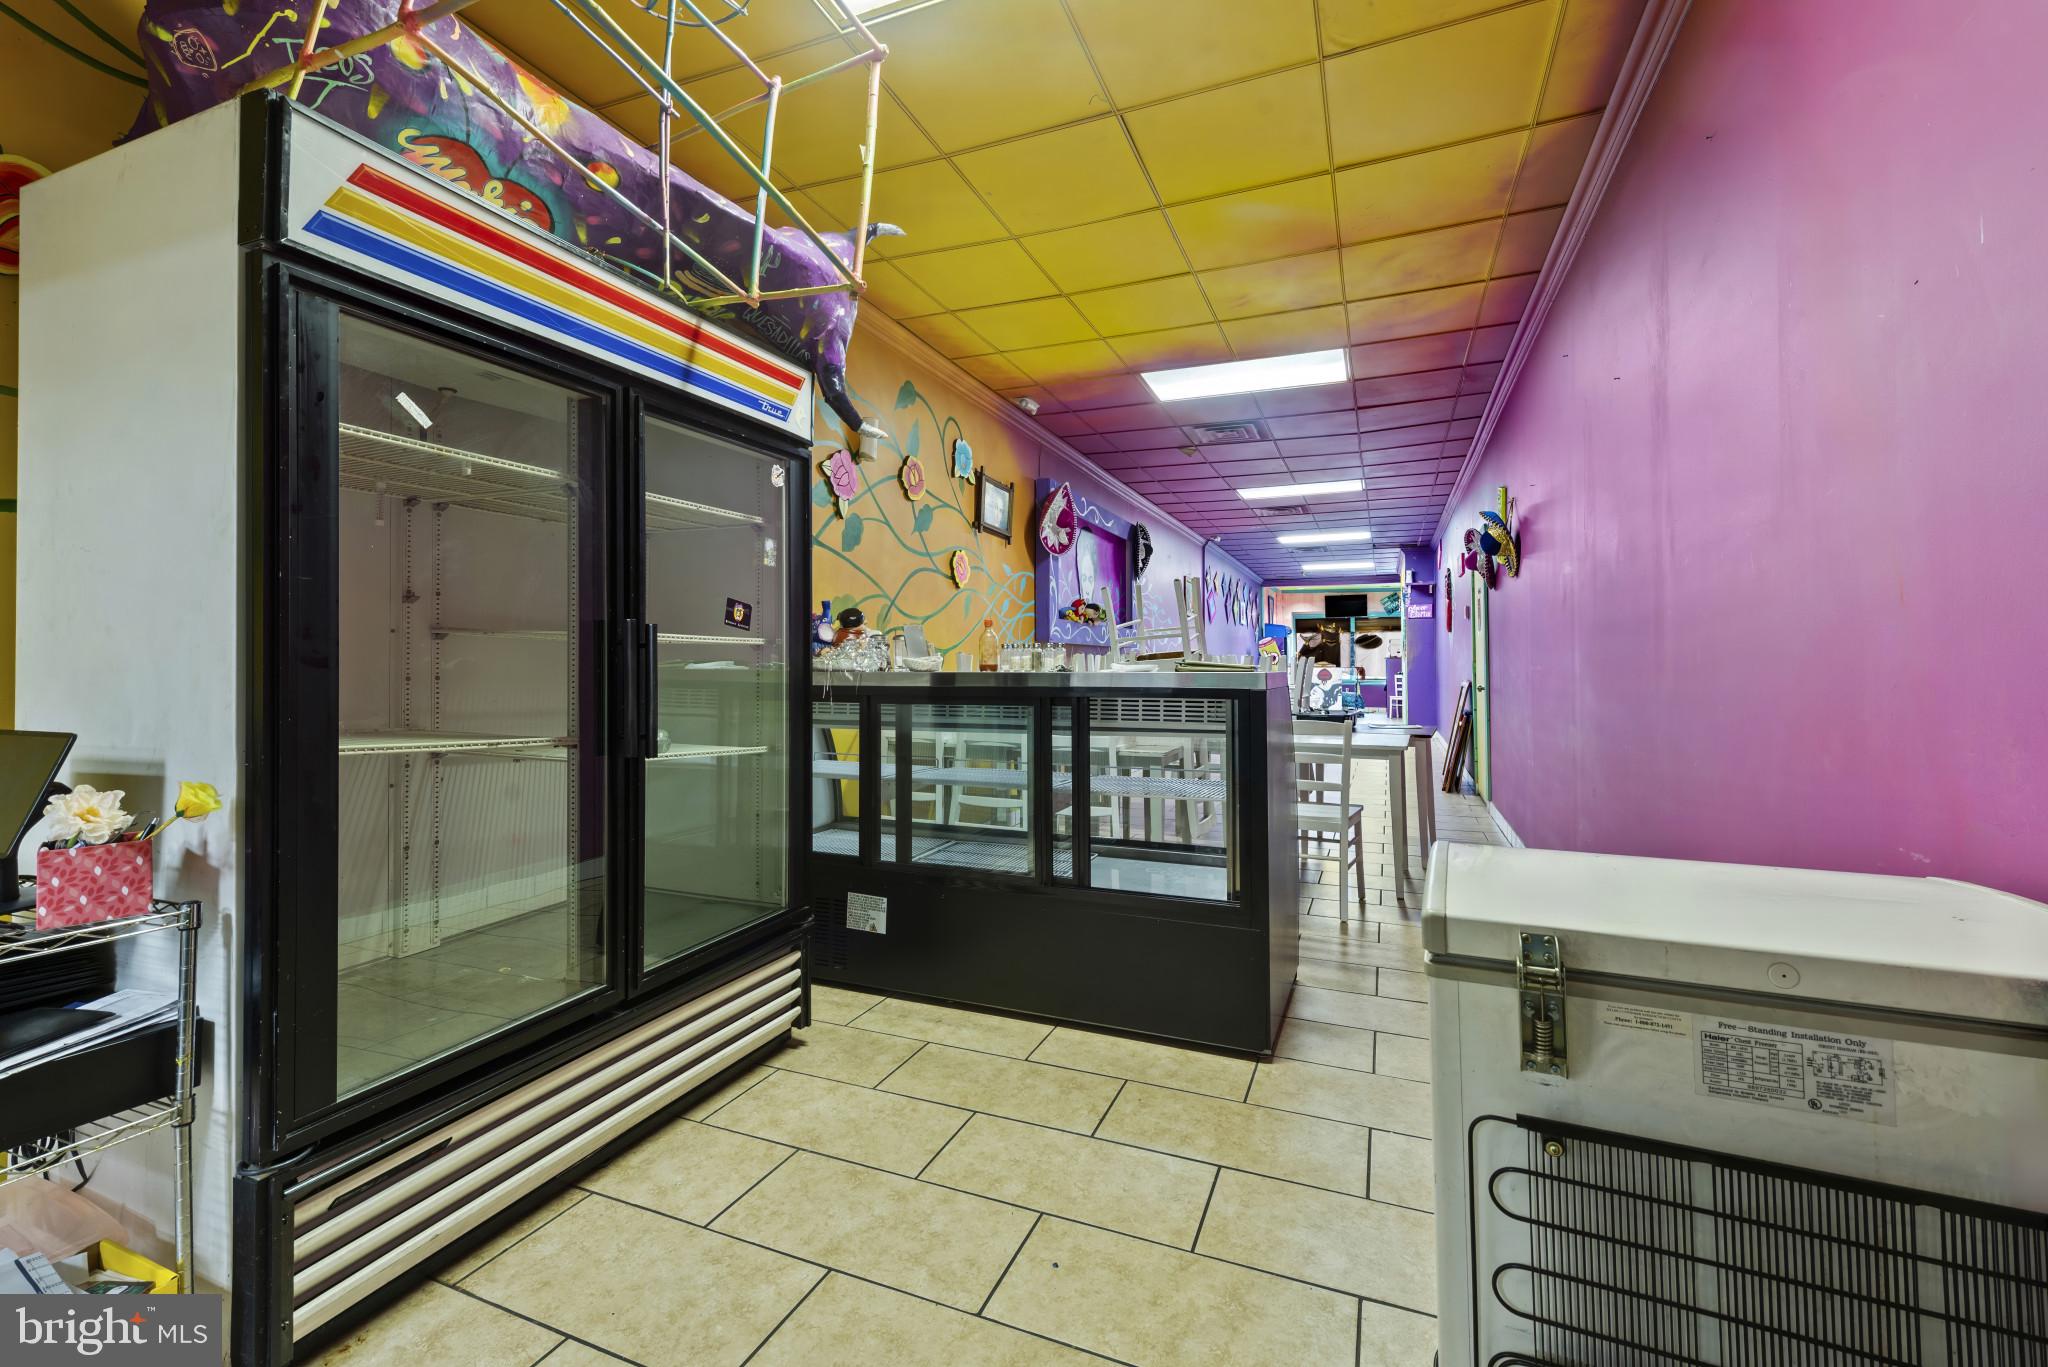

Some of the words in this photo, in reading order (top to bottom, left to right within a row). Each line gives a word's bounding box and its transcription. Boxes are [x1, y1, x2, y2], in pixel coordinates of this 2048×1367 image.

[272, 38, 375, 85] TOS
[1704, 1033, 1730, 1043] Haier
[1791, 1031, 1842, 1045] Installation
[1844, 1038, 1867, 1049] Only
